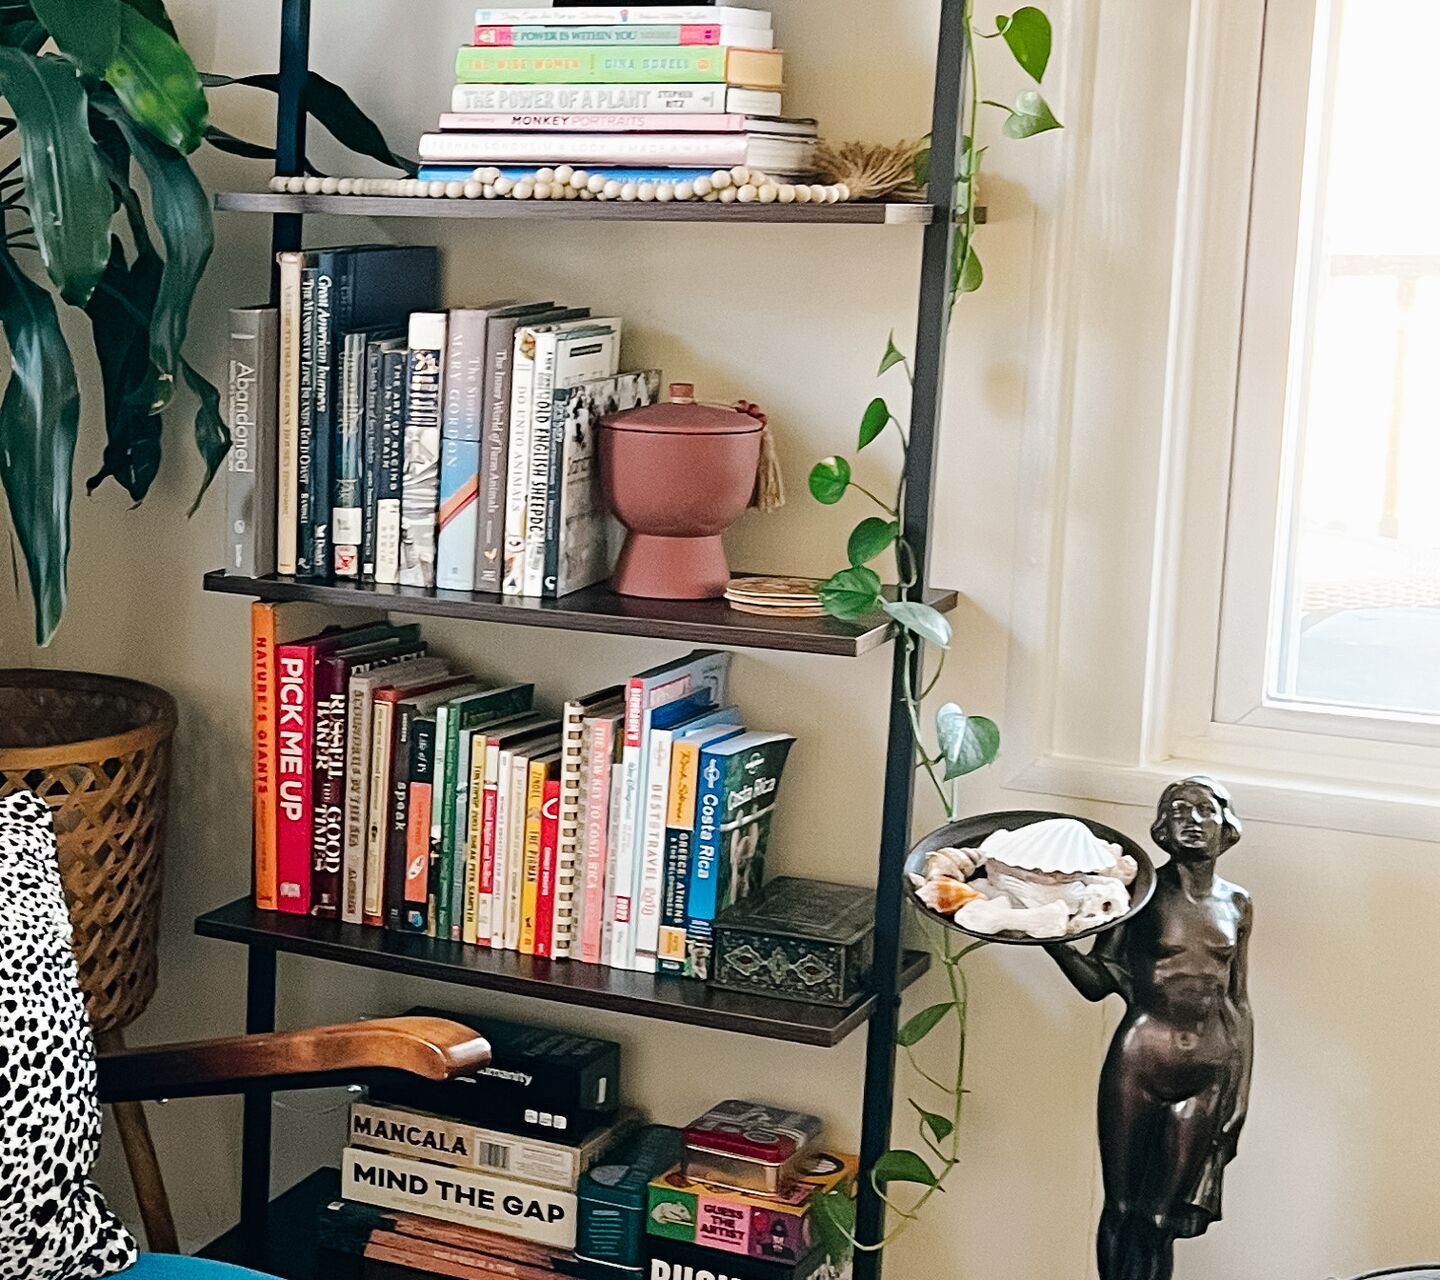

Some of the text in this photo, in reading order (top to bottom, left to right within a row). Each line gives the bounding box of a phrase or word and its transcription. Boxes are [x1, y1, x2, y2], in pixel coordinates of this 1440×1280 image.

[520, 30, 558, 41] POWER
[559, 30, 570, 41] IS
[572, 30, 612, 41] WITHIN
[614, 30, 638, 41] YOU
[463, 89, 652, 110] THE POWER OF A PLANT
[511, 115, 646, 127] MONKEY PORTRAITS
[302, 278, 315, 299] THE
[301, 361, 312, 386] LONG
[316, 274, 333, 413] Great American Journeys
[466, 356, 482, 382] The
[234, 361, 256, 473] Abandoned
[382, 385, 393, 470] IN THE RAIN
[389, 363, 402, 491] THE ART OF RACING
[446, 334, 464, 468] MARY GORDON
[464, 386, 479, 430] Stories
[487, 350, 508, 514] The Inner World of Farm Animals
[300, 427, 312, 453] GOLD
[510, 385, 527, 513] DO UNTO ANIMALS
[531, 401, 552, 477] OLD ENGLISH
[255, 636, 268, 722] NATURE'S
[257, 730, 269, 794] GIANTS
[279, 657, 305, 822] PICK ME UP
[315, 700, 331, 771] BAKER
[326, 693, 346, 781] RUSSELL
[417, 732, 429, 750] Life
[393, 781, 407, 831] speak
[586, 727, 605, 889] THE NEW KEY TO COSTA RICA
[727, 775, 777, 812] Costa Rica
[324, 805, 343, 874] GOOD
[526, 770, 542, 882] ZINDEL THE PIGMAN
[697, 793, 720, 880] Costa Rica
[645, 833, 660, 882] TRAVEL
[673, 881, 686, 924] ATHENS
[353, 1114, 469, 1157] MANCALA
[353, 1162, 429, 1196] MIND
[435, 1179, 496, 1212] THE
[502, 1194, 566, 1224] GAP
[703, 1204, 745, 1220] GUESS
[710, 1215, 736, 1229] THE
[700, 1223, 746, 1240] ARTIST
